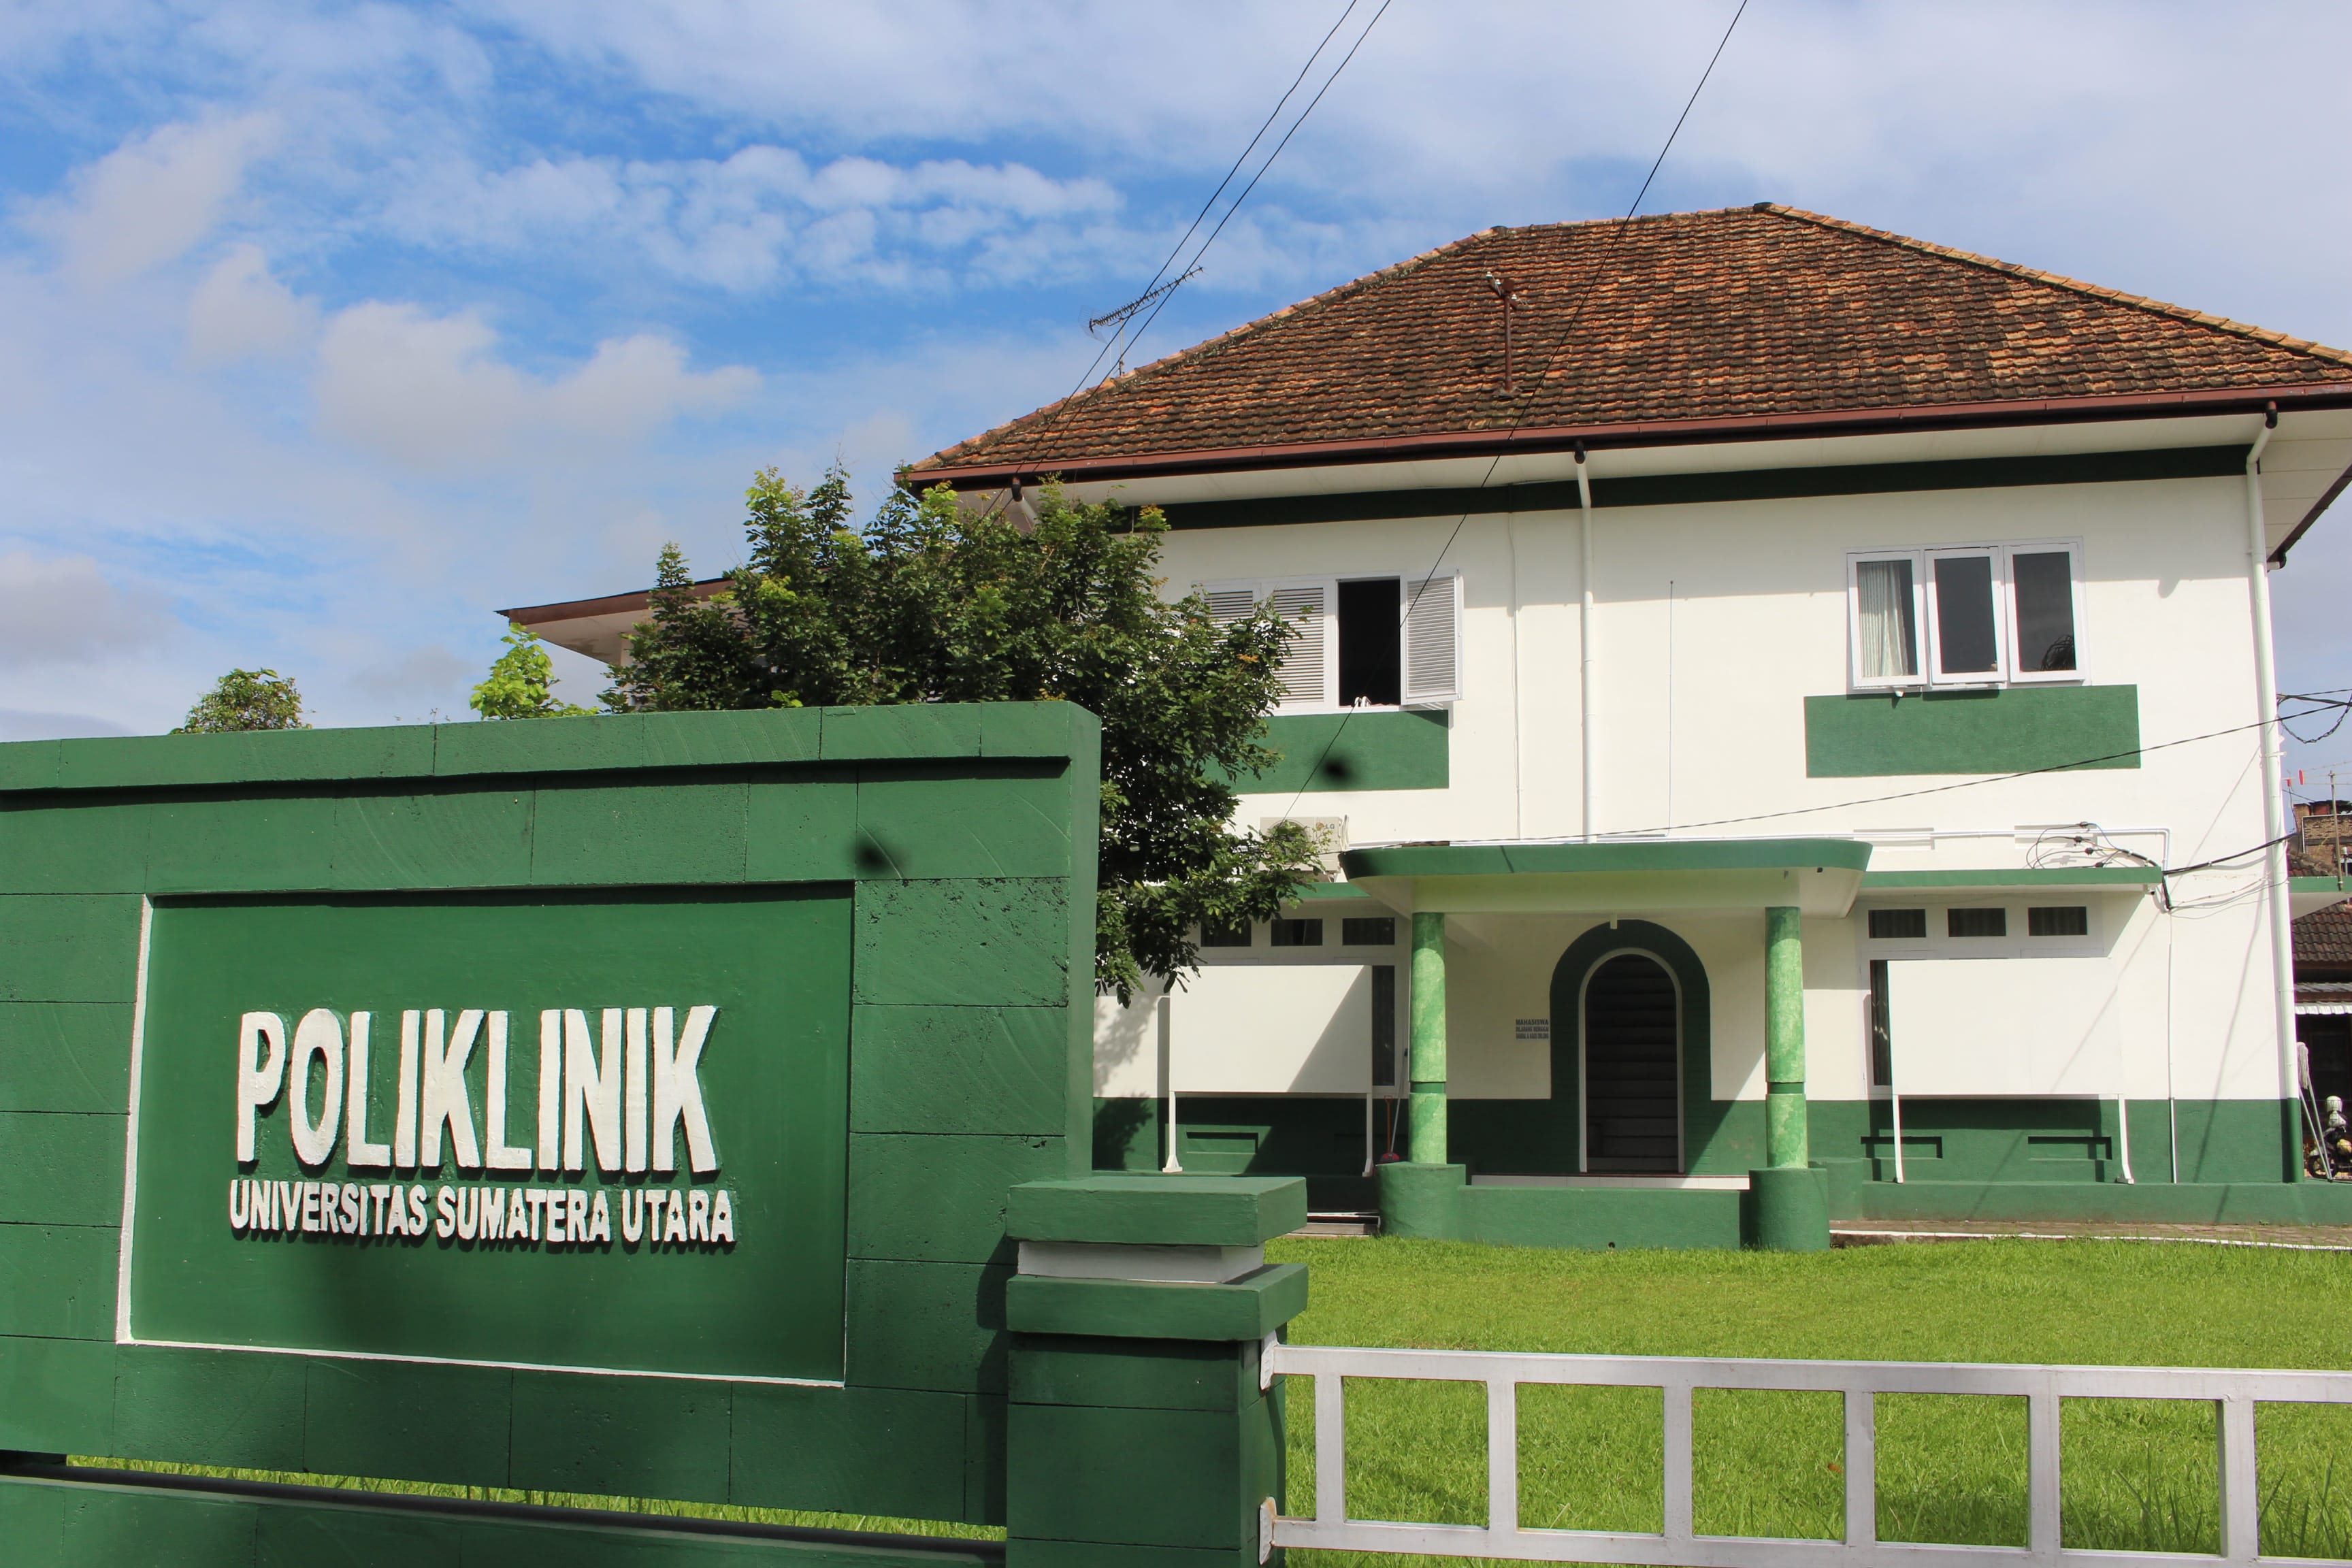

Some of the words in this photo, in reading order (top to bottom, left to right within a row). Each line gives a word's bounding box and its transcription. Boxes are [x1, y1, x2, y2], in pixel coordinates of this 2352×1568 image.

[237, 1005, 717, 1173] POLIKLINIK
[229, 1179, 430, 1237] UNIVERSITAS
[435, 1185, 610, 1243] SUMATERA
[621, 1189, 735, 1243] UTARA
